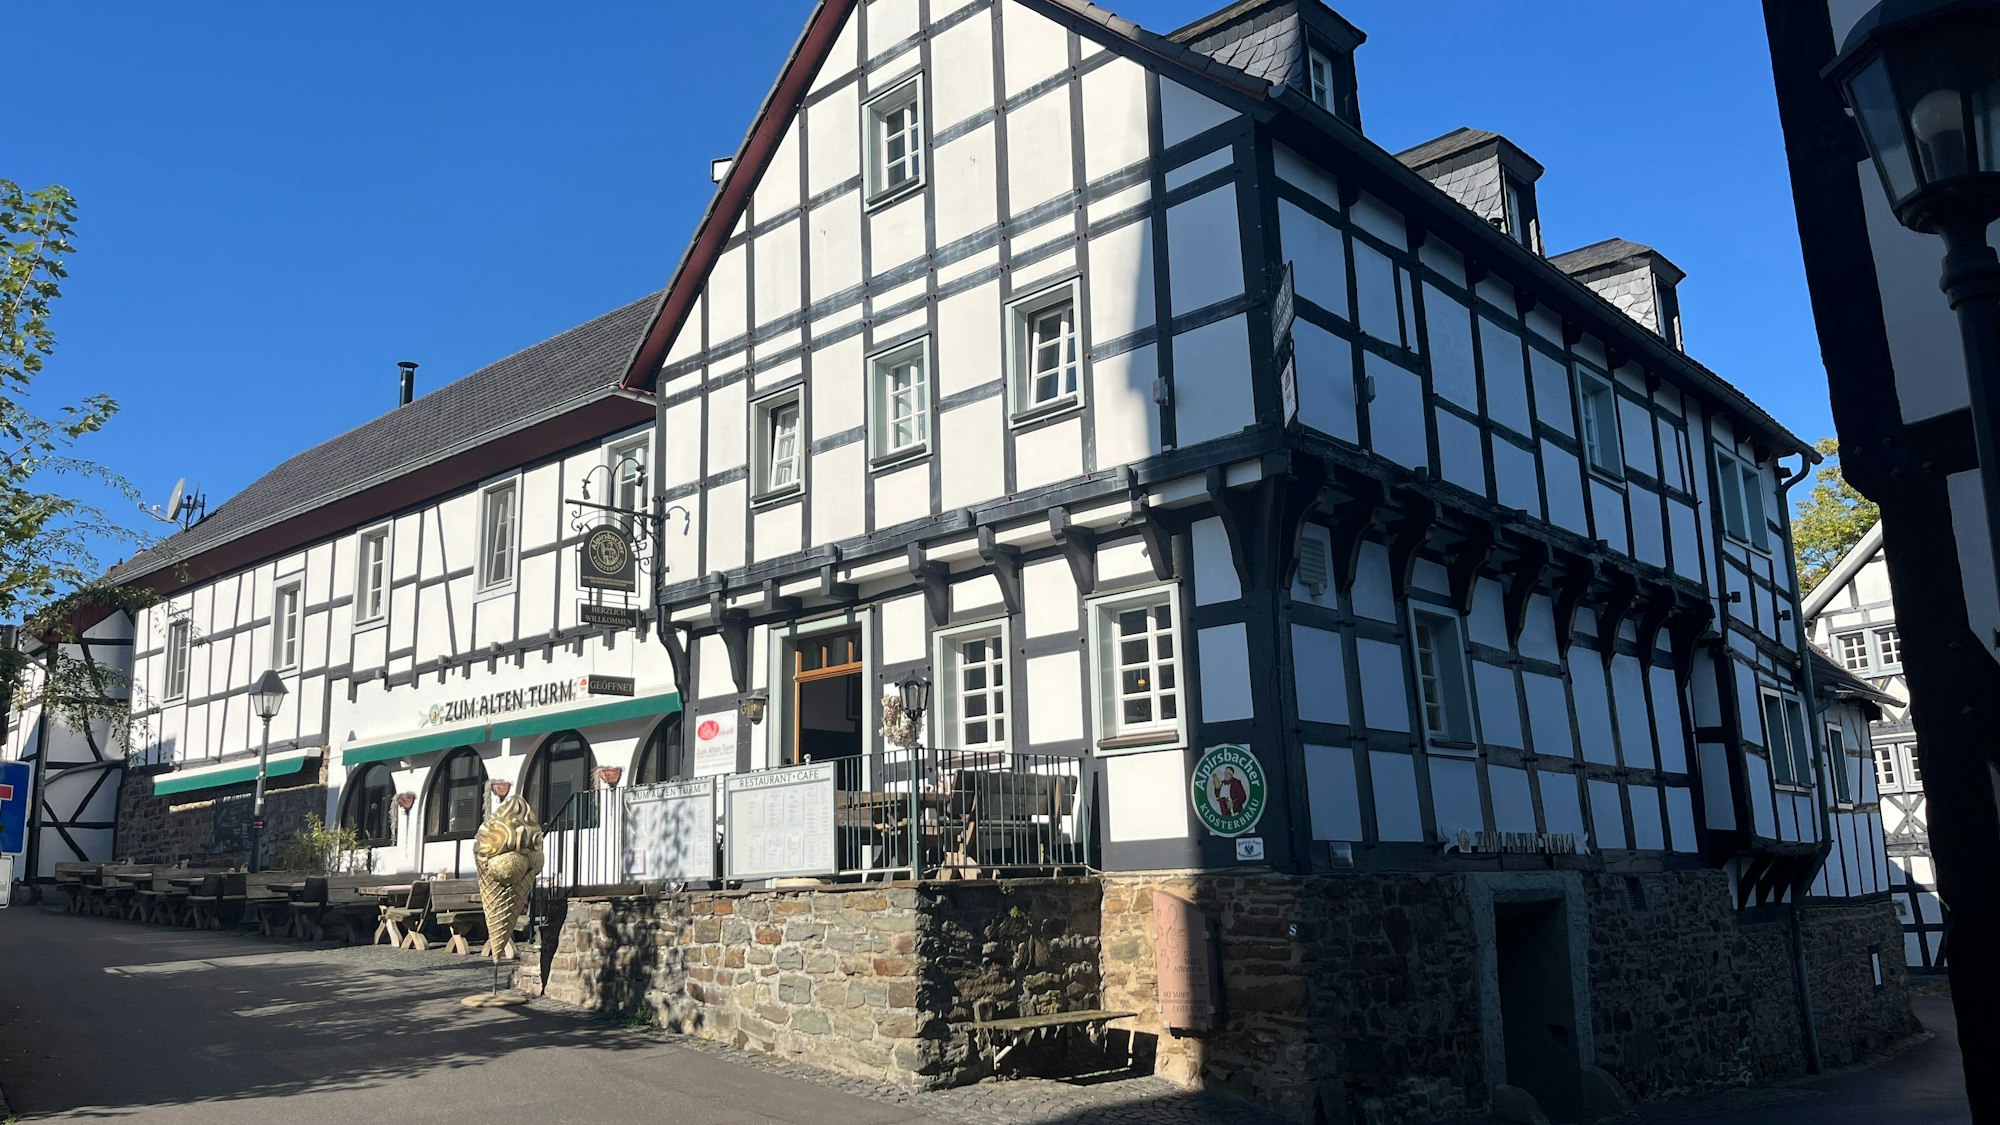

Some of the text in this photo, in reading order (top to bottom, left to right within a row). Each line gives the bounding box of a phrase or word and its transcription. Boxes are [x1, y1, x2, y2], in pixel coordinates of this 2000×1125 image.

[591, 606, 626, 616] HERZLICH
[585, 614, 633, 625] WILLKOMMEN
[589, 679, 634, 692] GEÖFFNET
[444, 679, 573, 722] ZUM ALTEN TURM
[1195, 748, 1260, 791] Alpirsbacher
[739, 774, 792, 788] RESTAURANT
[632, 789, 650, 801] ZUM
[678, 784, 702, 796] TURM
[1199, 798, 1260, 830] KLOSTERBRÄU
